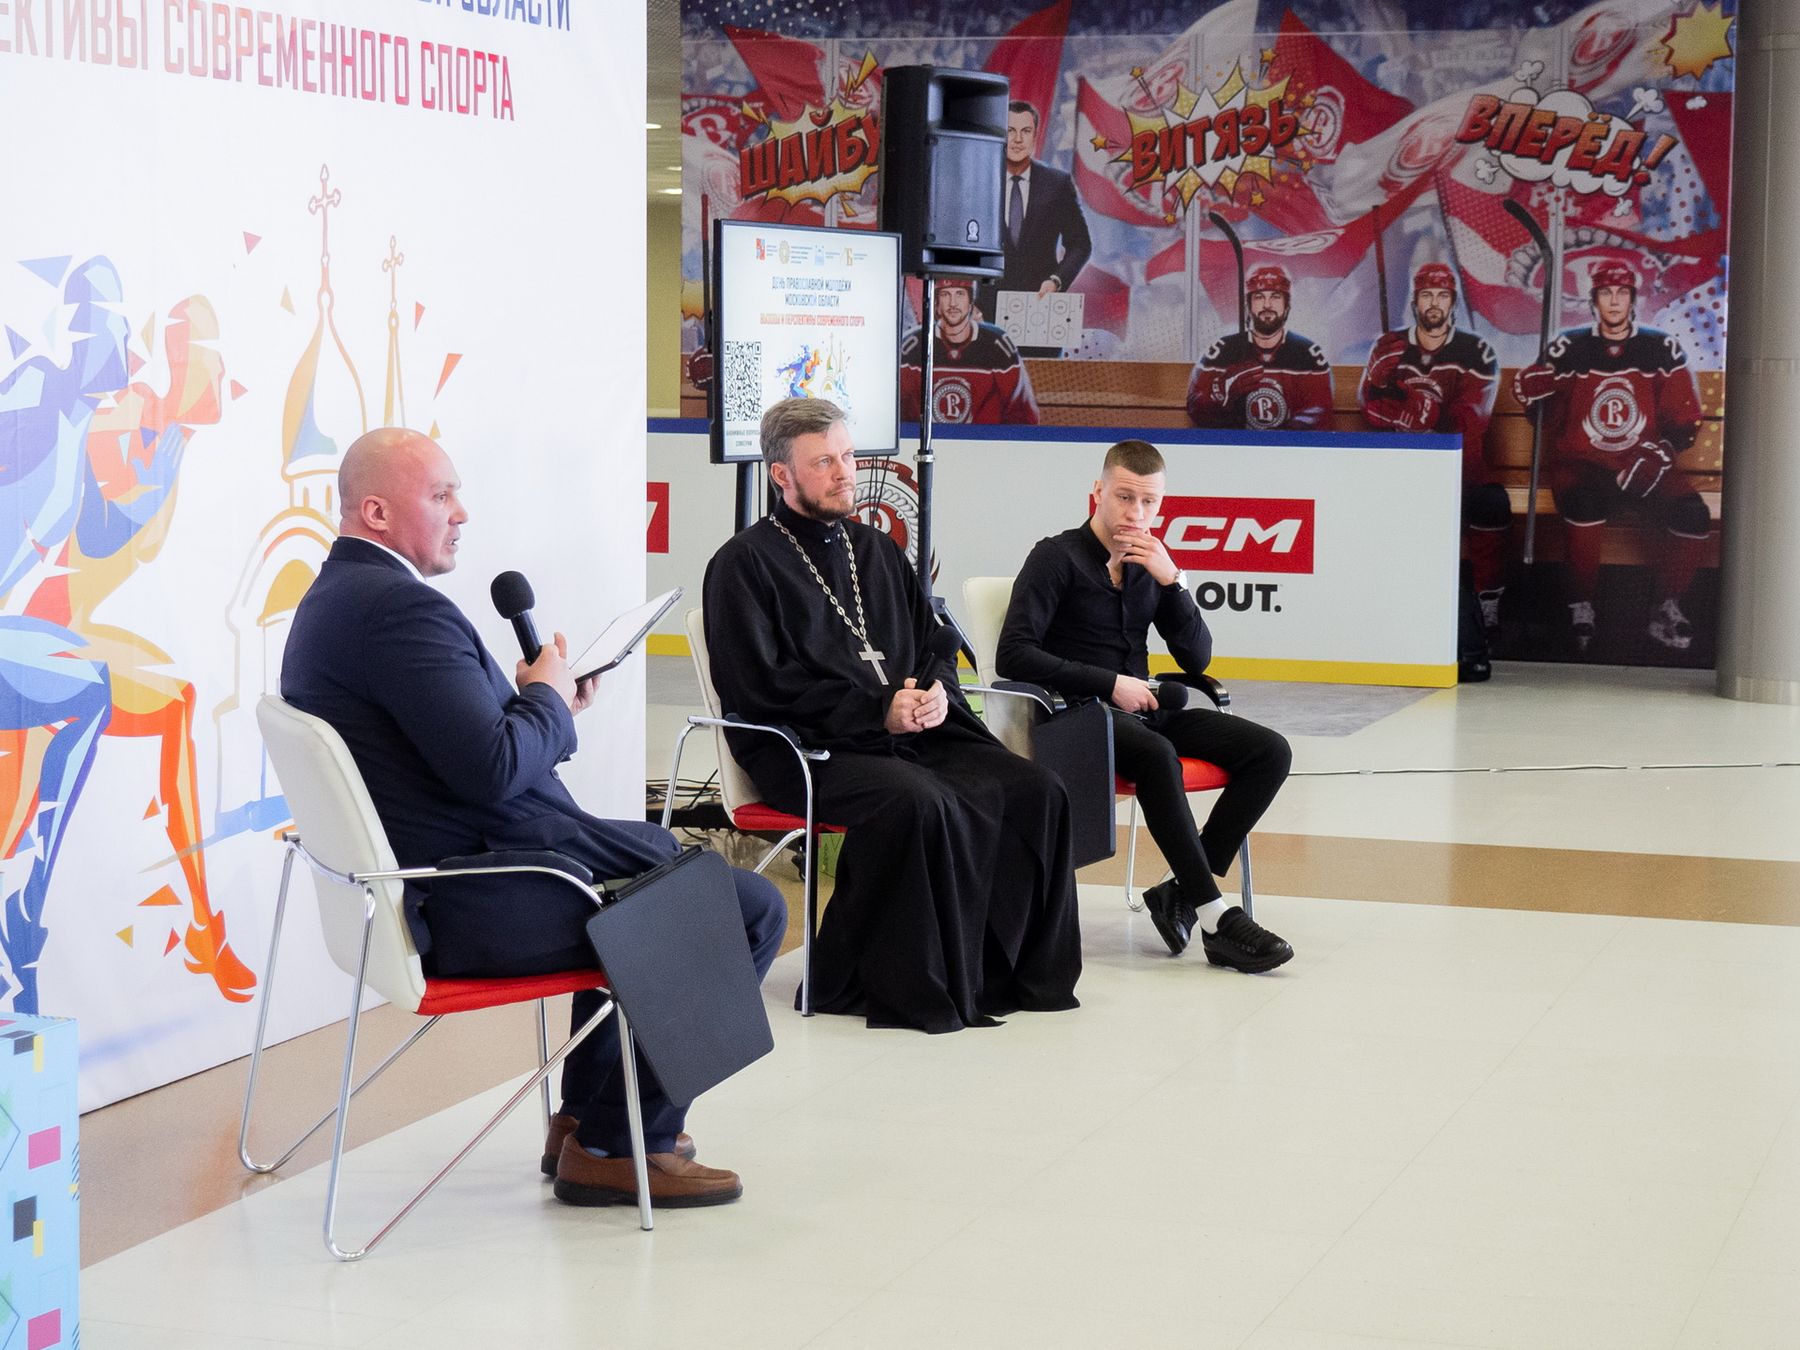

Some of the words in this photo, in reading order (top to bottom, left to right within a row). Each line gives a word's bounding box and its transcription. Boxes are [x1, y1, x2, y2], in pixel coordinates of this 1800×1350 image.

[164, 0, 410, 106] СОВРЕМЕННОГО
[420, 41, 515, 121] СПОРТА
[1131, 98, 1299, 183] ВИТЯЗЬ
[1454, 95, 1680, 187] ВПЕРЁД!
[1150, 515, 1303, 553] CM
[1195, 581, 1282, 613] OUT.
